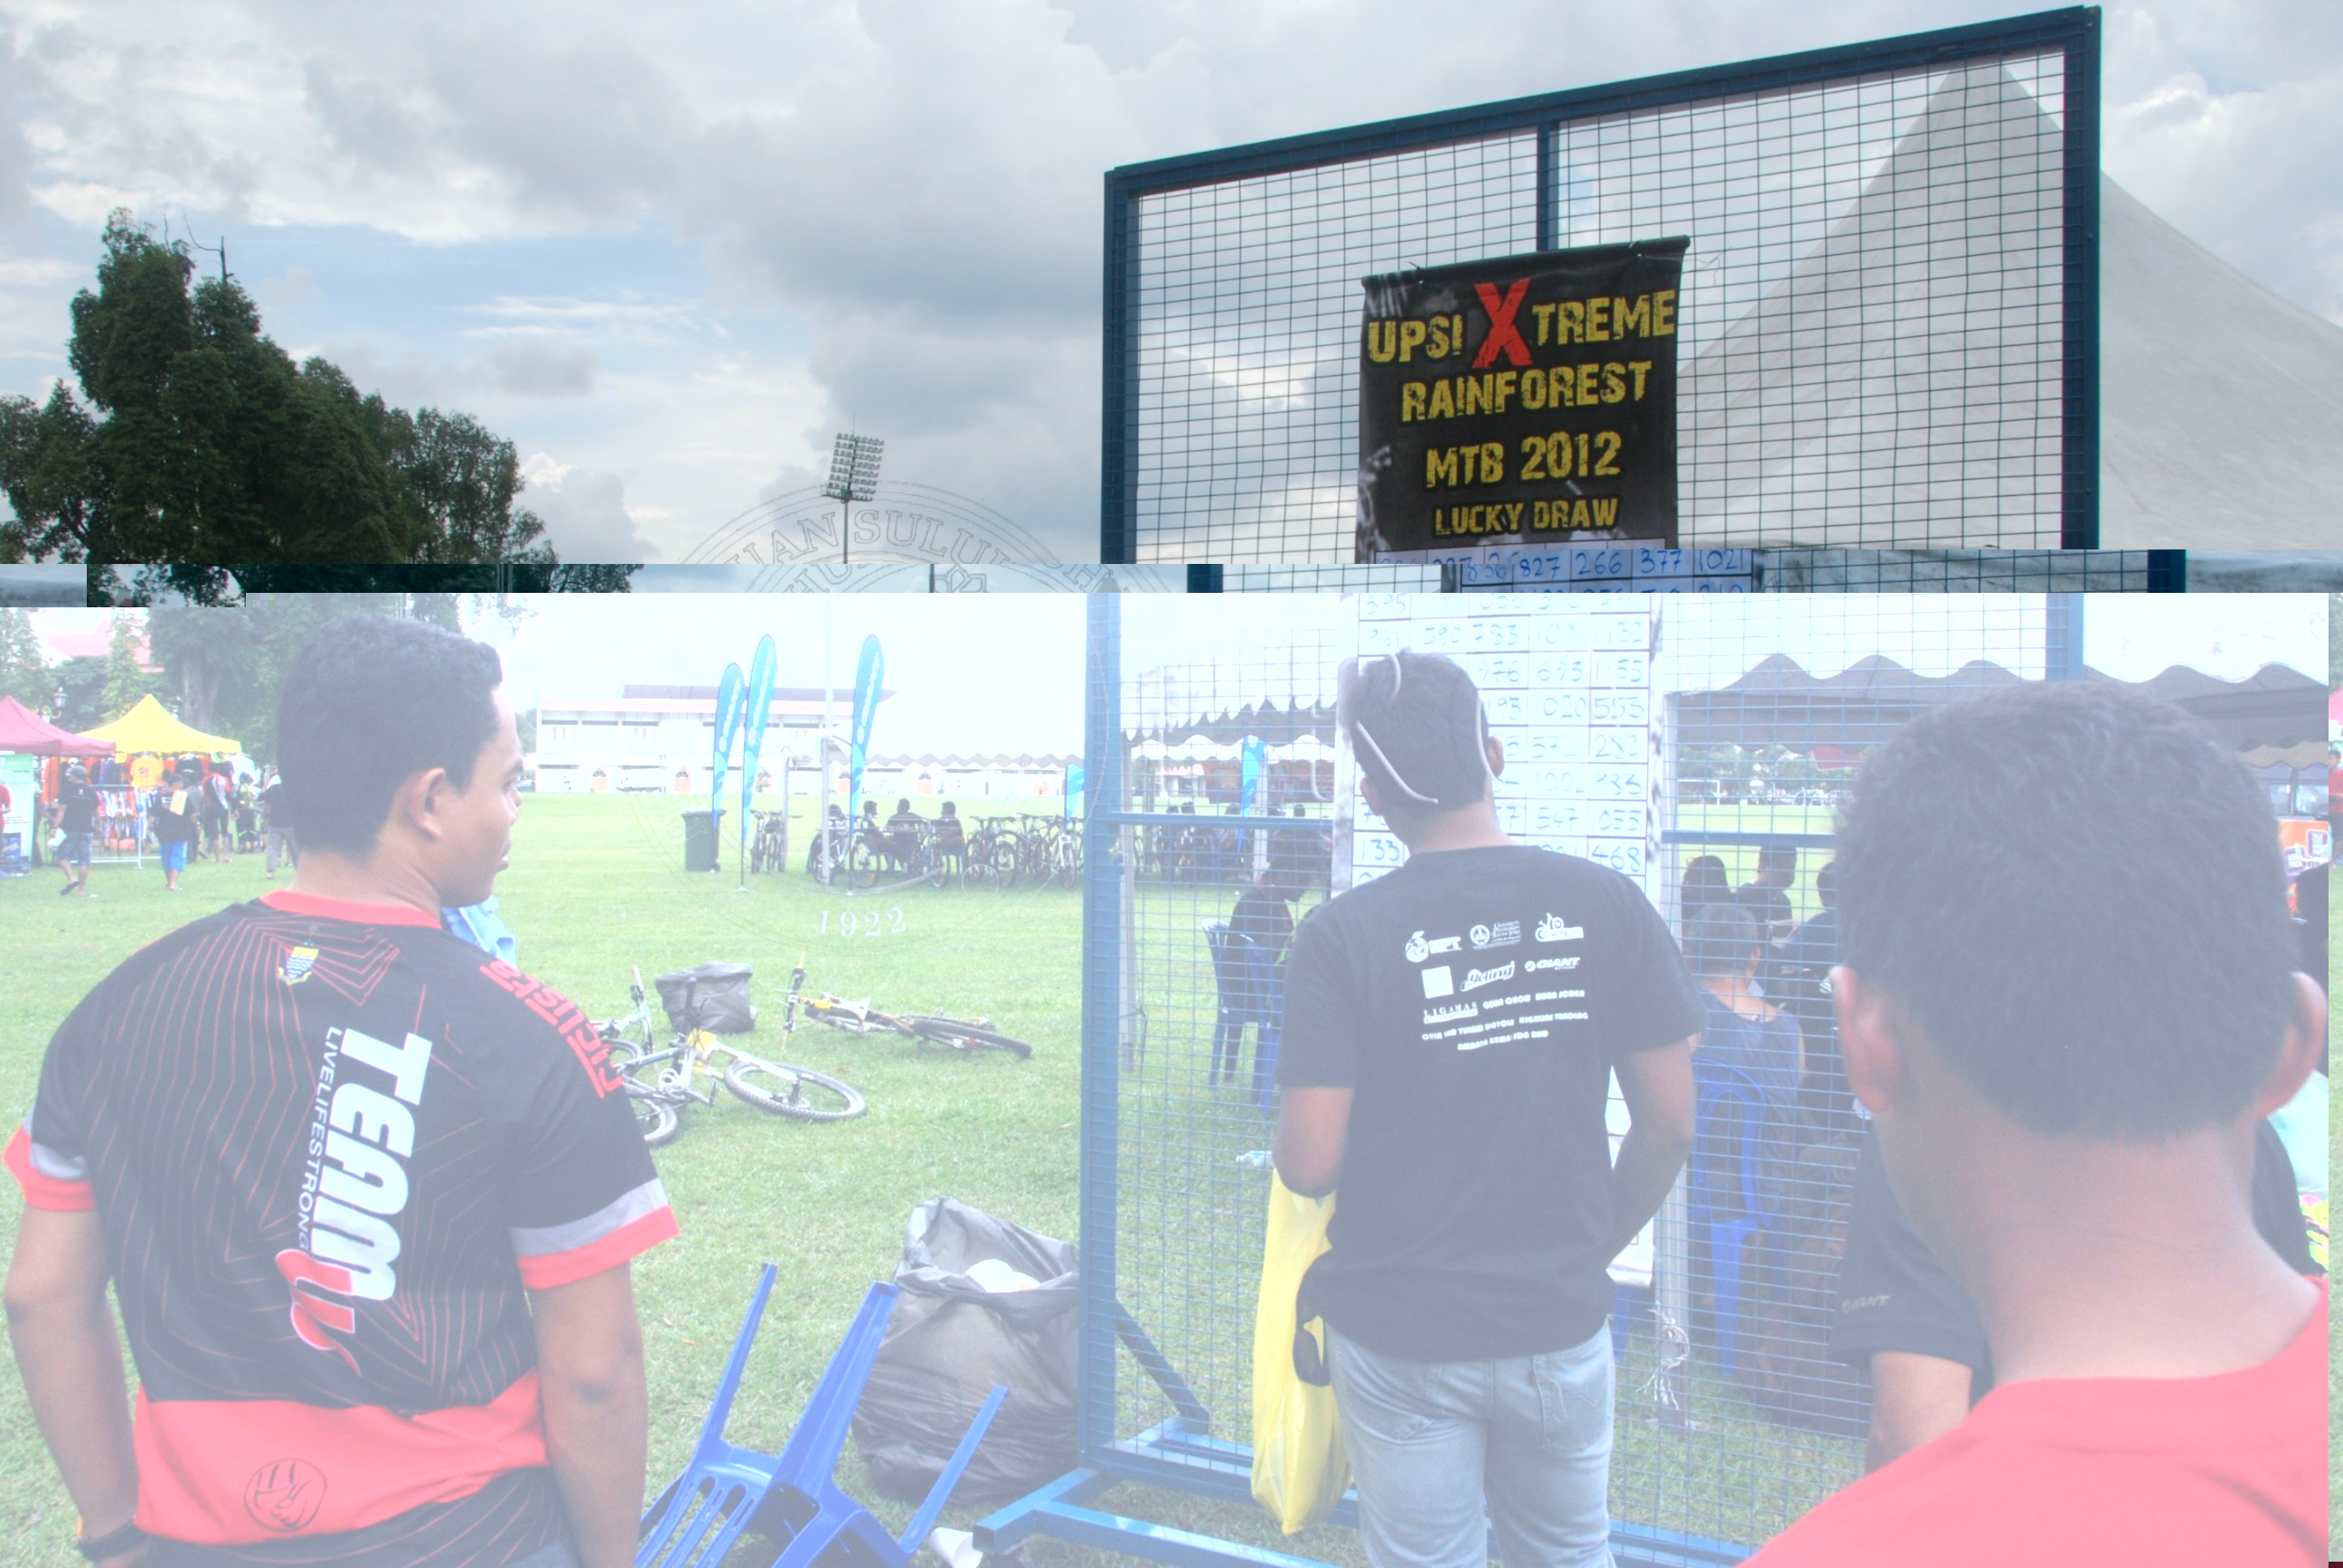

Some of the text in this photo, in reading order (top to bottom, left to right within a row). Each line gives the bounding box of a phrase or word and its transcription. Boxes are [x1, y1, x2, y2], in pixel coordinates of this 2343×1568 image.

[1368, 314, 1463, 363] UPSI
[1401, 361, 1652, 422] RAINFOREST
[1426, 430, 1622, 488] MTB 2012
[1435, 498, 1619, 535] LUCKY DRAW
[1520, 555, 1560, 580] 827
[1576, 551, 1623, 576] 266
[1641, 549, 1681, 574] 377
[1592, 843, 1645, 872] 468
[296, 1026, 343, 1251] LIVELIFESTRONG
